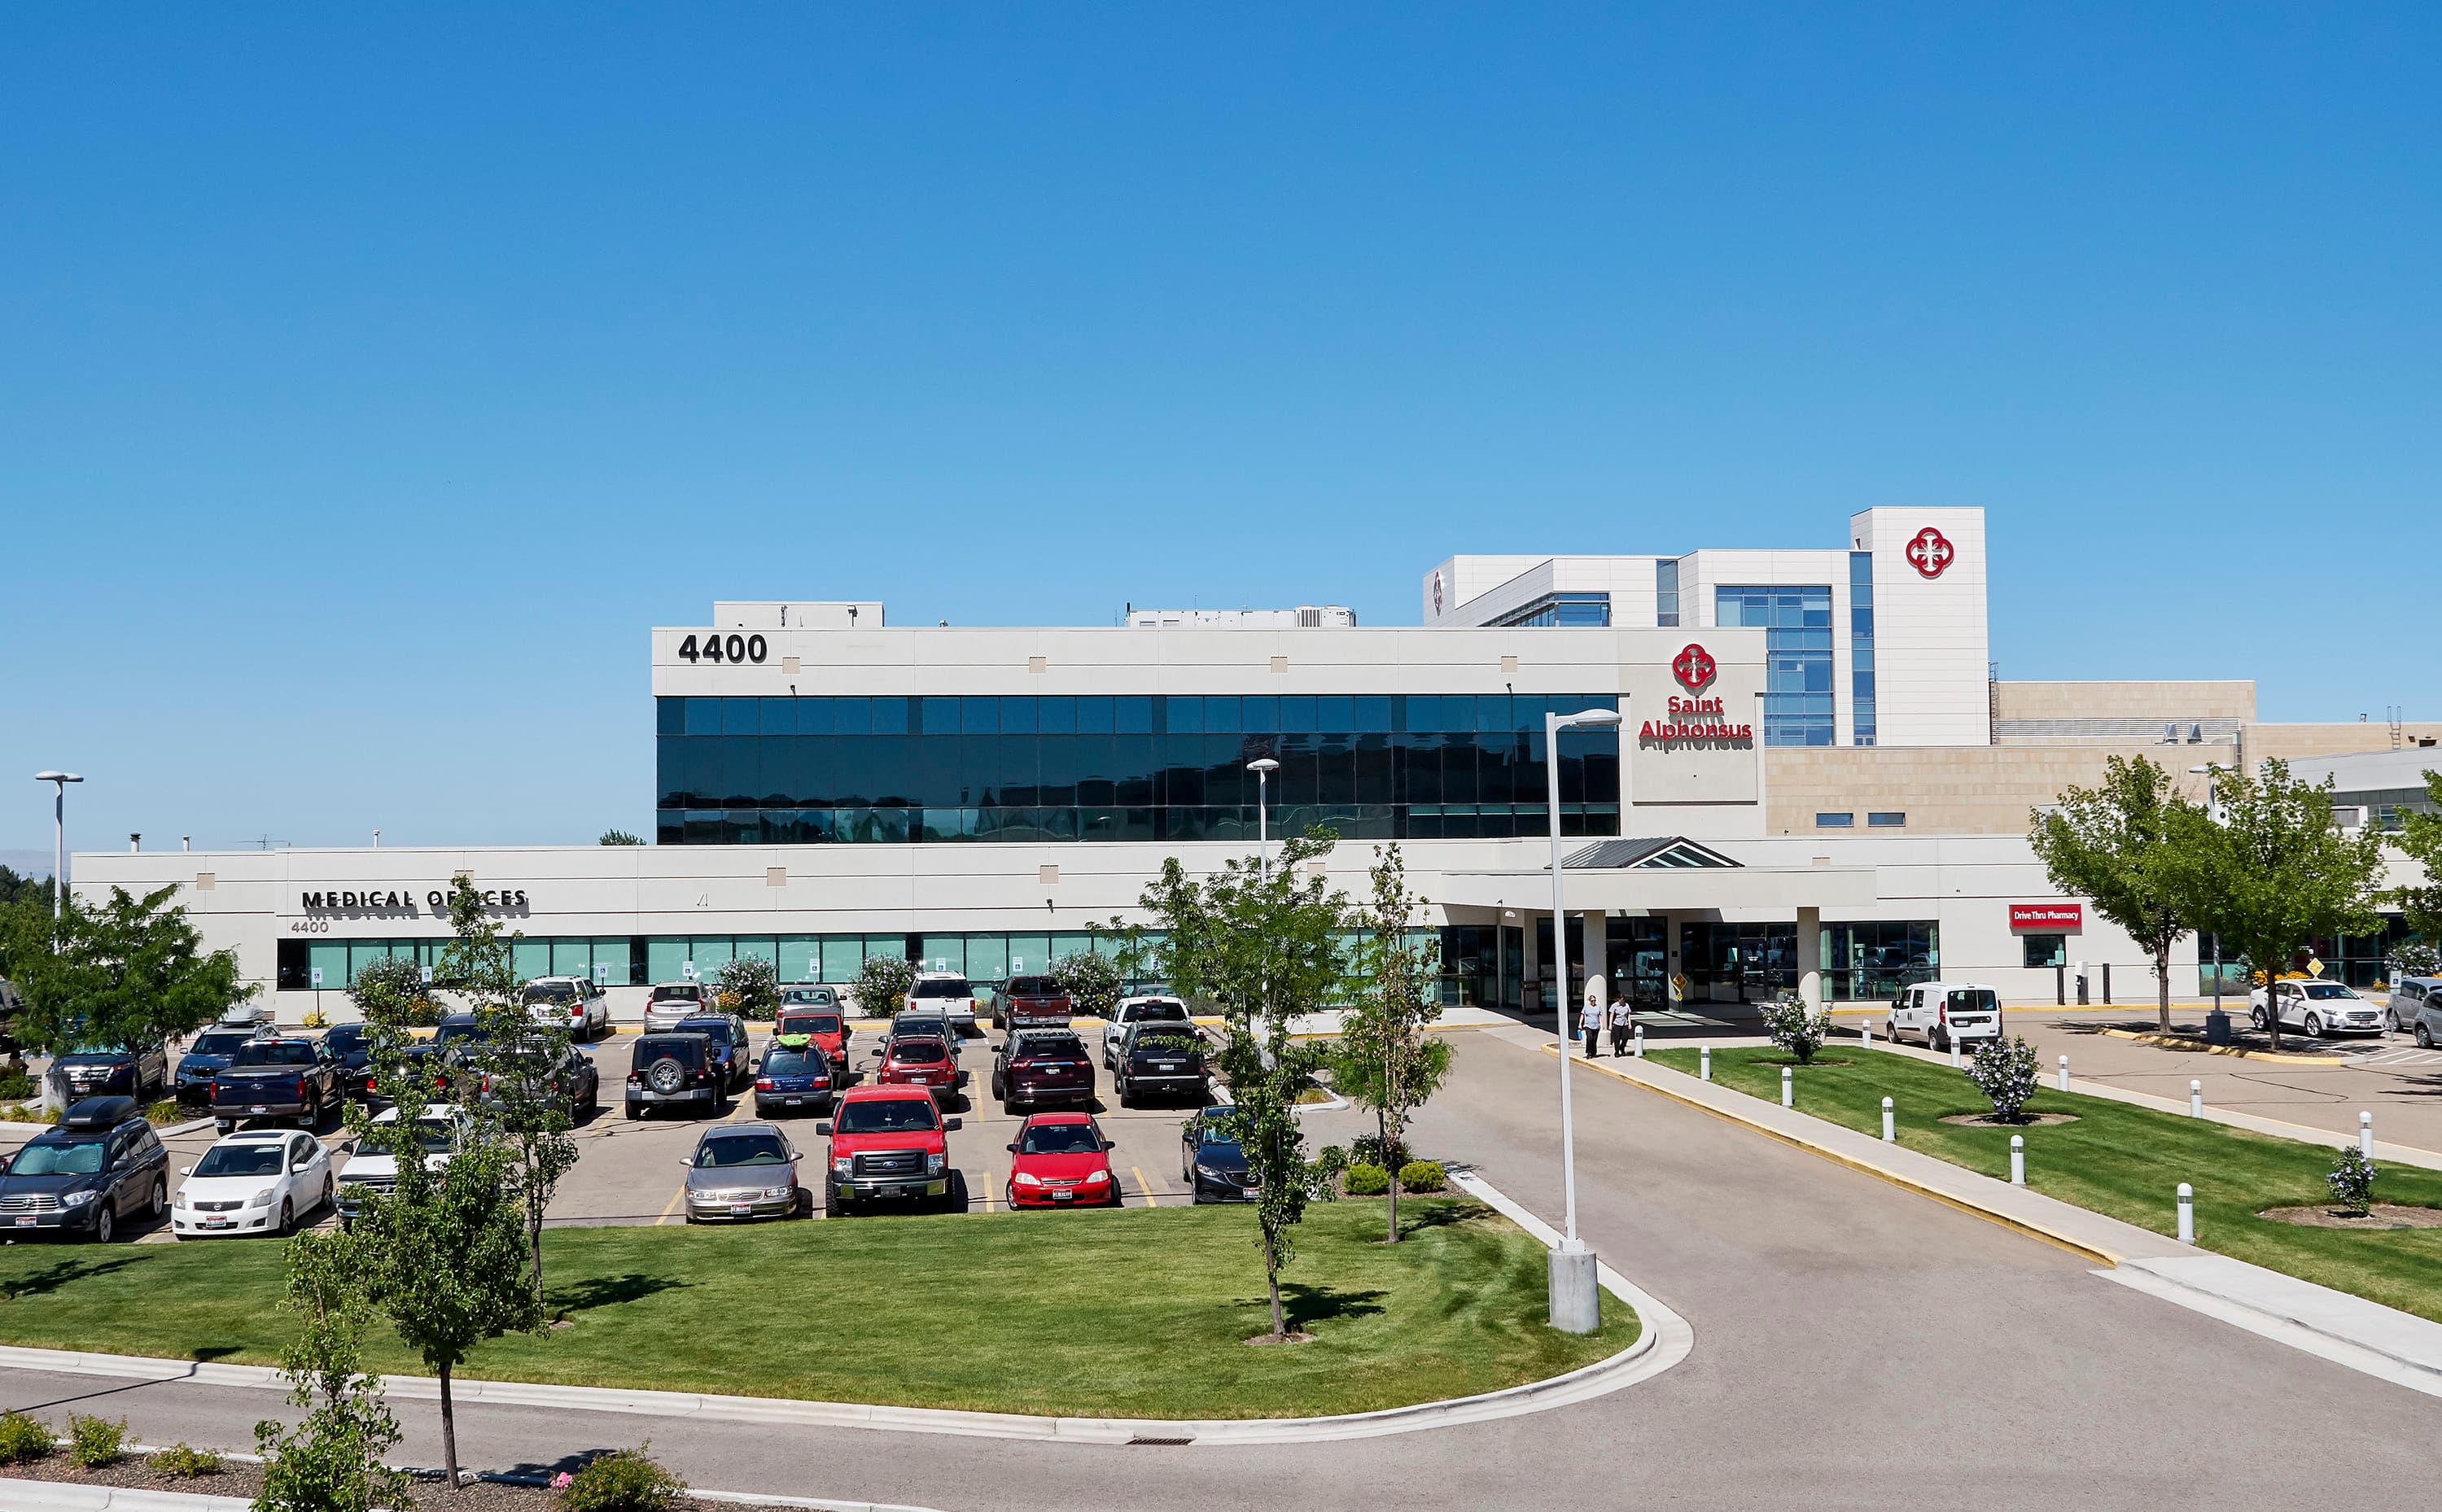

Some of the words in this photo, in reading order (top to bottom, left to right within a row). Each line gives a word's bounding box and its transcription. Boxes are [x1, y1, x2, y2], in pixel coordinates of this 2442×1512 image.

[679, 634, 767, 663] 4400
[1668, 695, 1723, 713] Saint
[1639, 720, 1752, 741] Alphonsus
[302, 891, 414, 907] MEDICAL
[2014, 911, 2032, 920] Drive
[2032, 911, 2046, 920] Thru
[2047, 911, 2079, 921] Pharmacy
[291, 922, 329, 933] 4400
